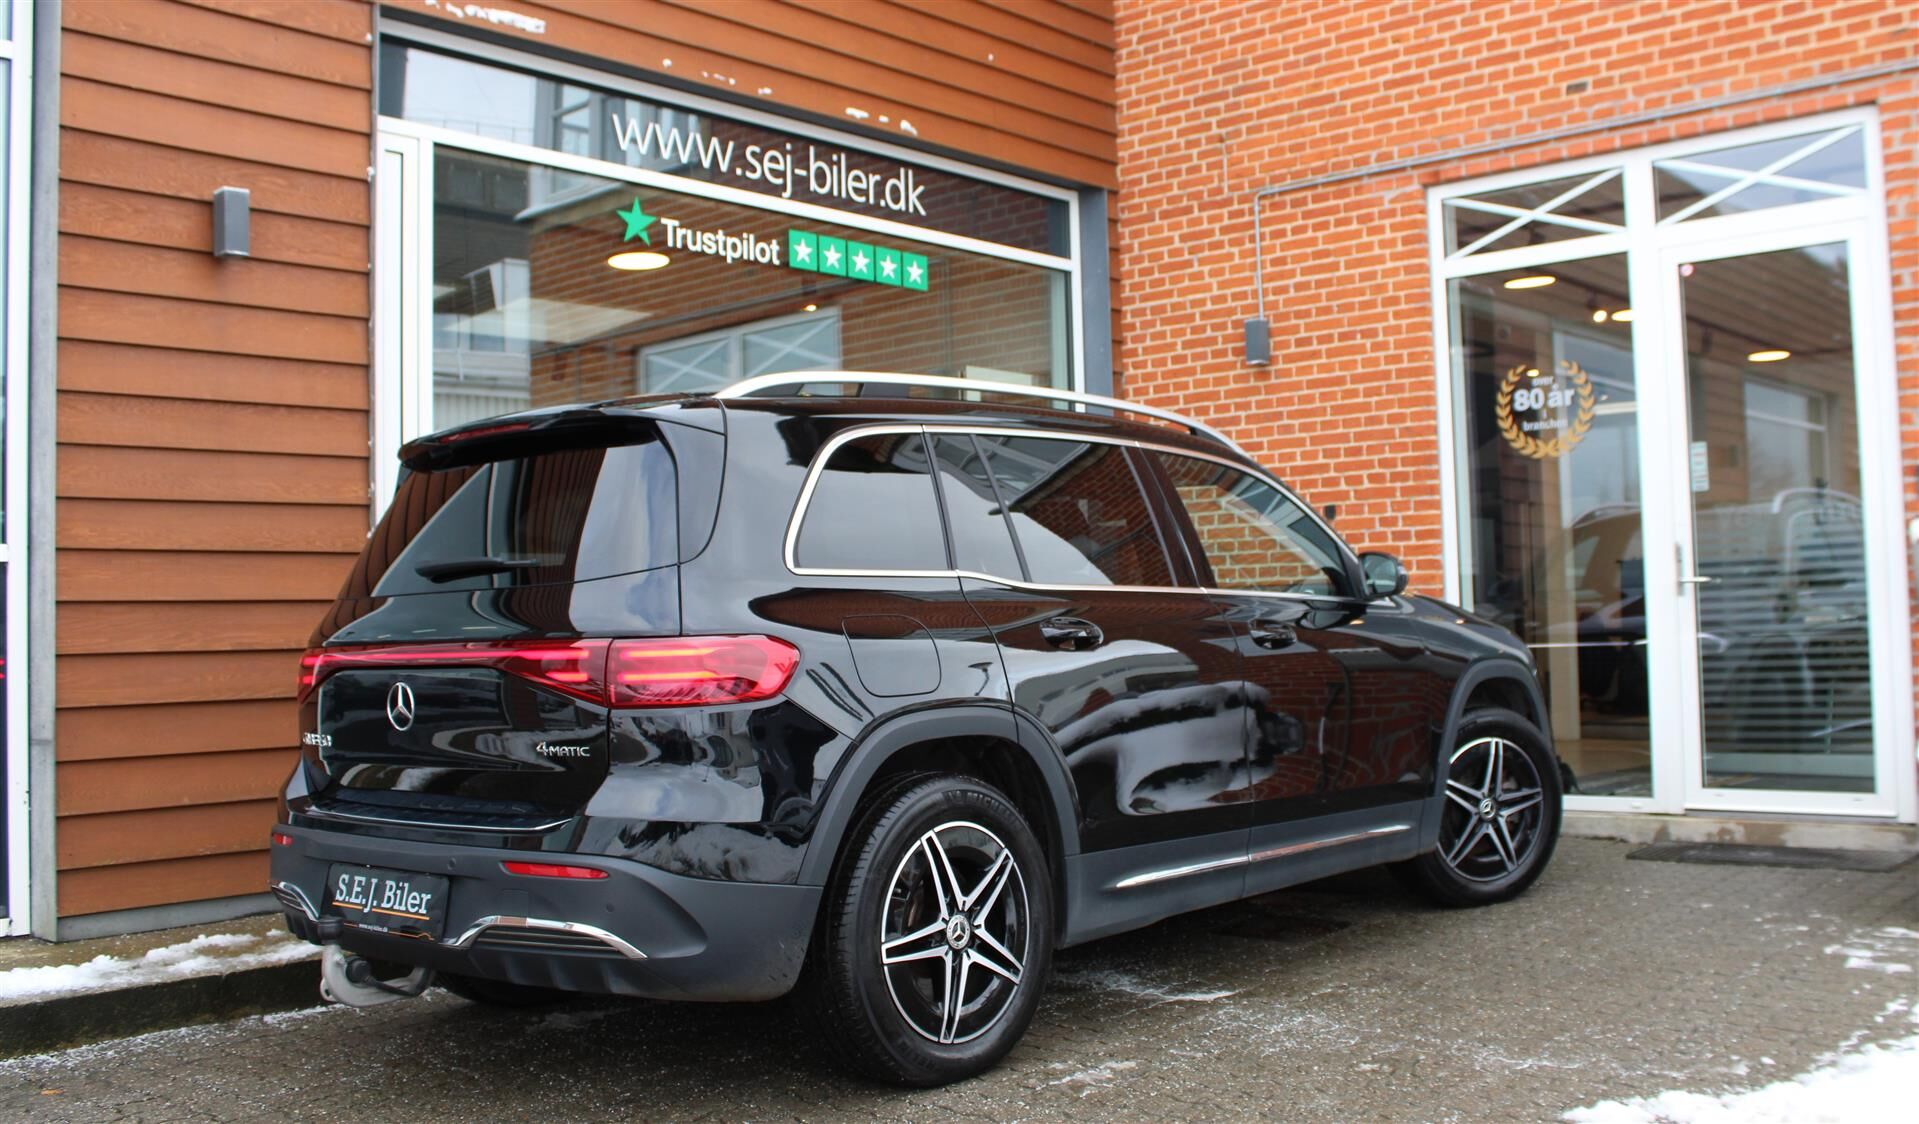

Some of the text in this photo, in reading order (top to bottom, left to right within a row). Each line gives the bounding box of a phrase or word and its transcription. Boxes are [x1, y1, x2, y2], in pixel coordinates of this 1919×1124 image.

[612, 113, 927, 216] www.sej-biler.dk
[661, 217, 780, 265] Trustpilot
[1513, 382, 1575, 412] 80 år
[536, 741, 590, 757] 4MATIC
[335, 873, 432, 914] S.E.J. Biler
